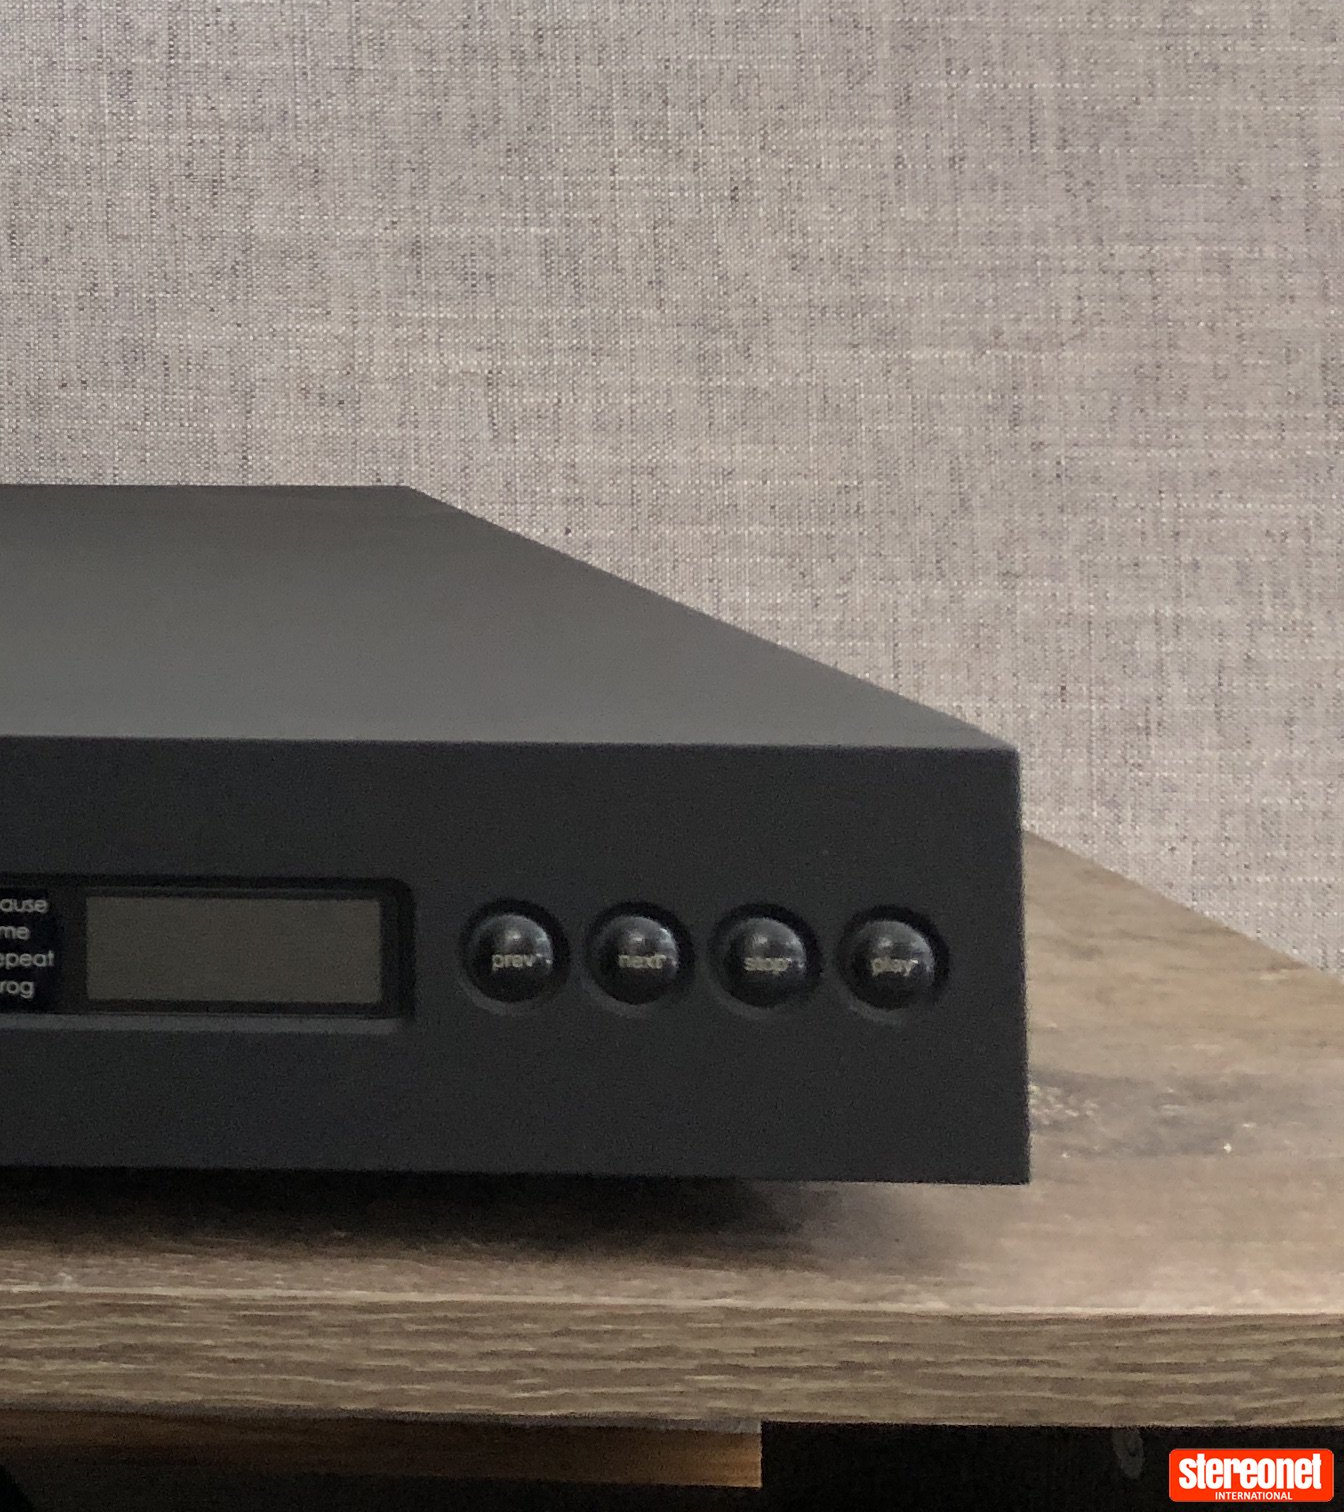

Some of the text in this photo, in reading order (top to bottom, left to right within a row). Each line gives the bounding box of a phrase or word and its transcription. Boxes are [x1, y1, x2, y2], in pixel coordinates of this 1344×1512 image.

[492, 954, 536, 972] prev
[618, 954, 667, 970] next
[743, 956, 792, 975] stop
[870, 957, 918, 977] play
